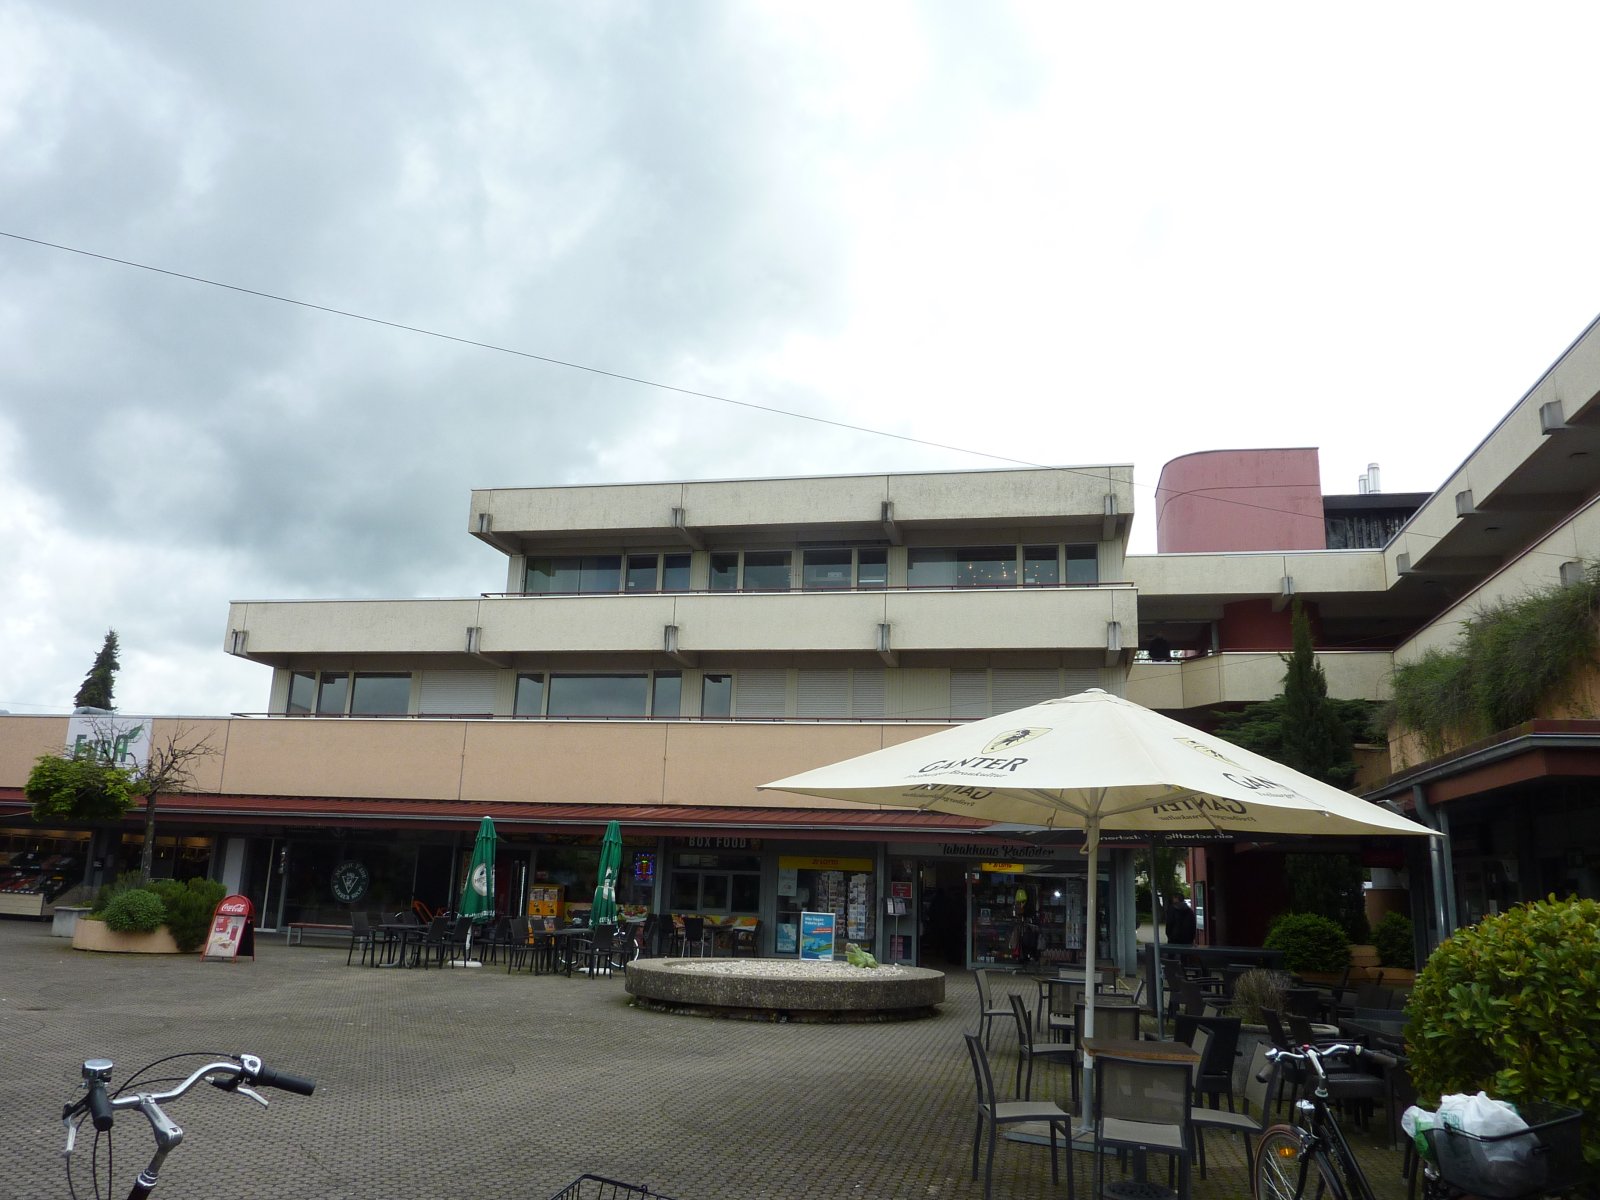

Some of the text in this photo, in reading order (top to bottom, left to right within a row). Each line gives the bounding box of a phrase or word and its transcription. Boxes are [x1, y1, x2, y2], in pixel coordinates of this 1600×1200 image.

[918, 757, 1028, 773] GANTER
[688, 836, 746, 849] BOX FOOD
